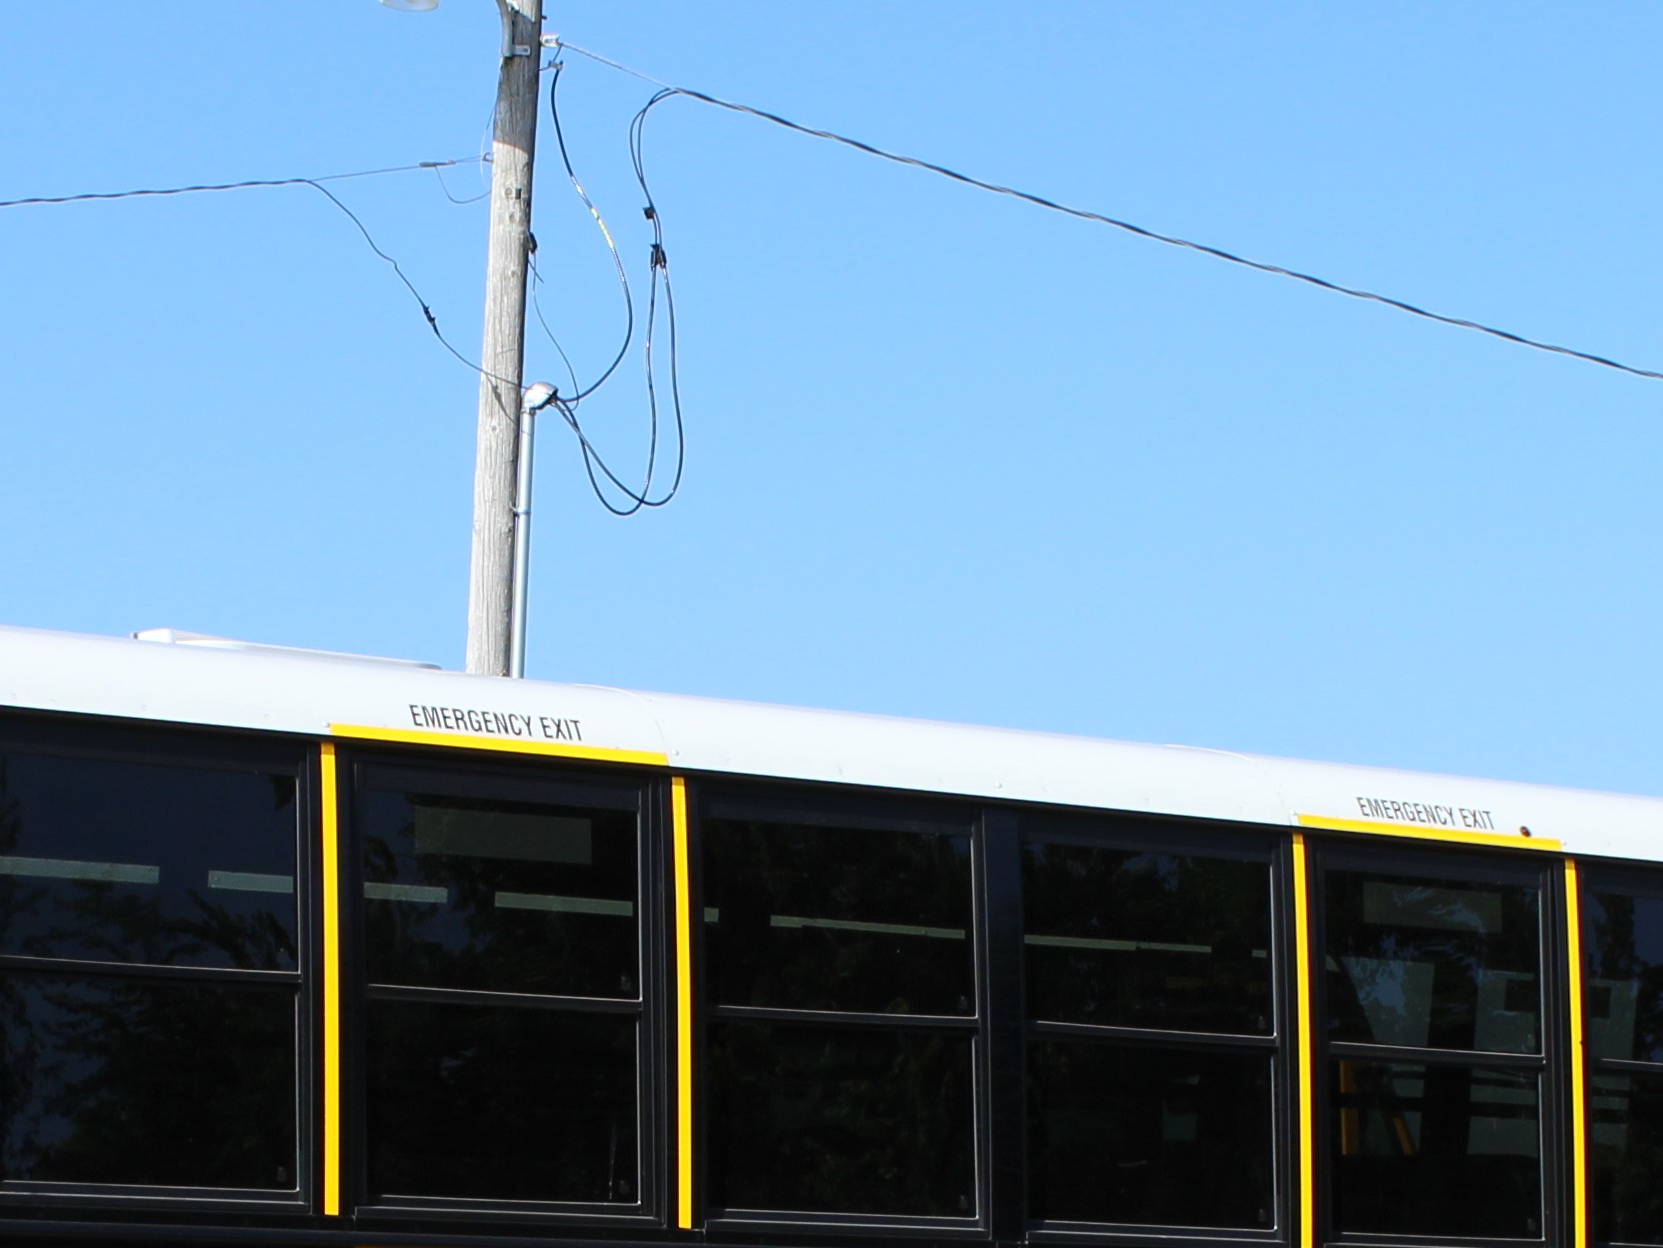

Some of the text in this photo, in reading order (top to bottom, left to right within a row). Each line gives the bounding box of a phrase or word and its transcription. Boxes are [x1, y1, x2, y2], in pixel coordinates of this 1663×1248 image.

[409, 704, 582, 741] EMERGENCY EXIT
[1356, 796, 1494, 830] EMERGENCY EXIT
